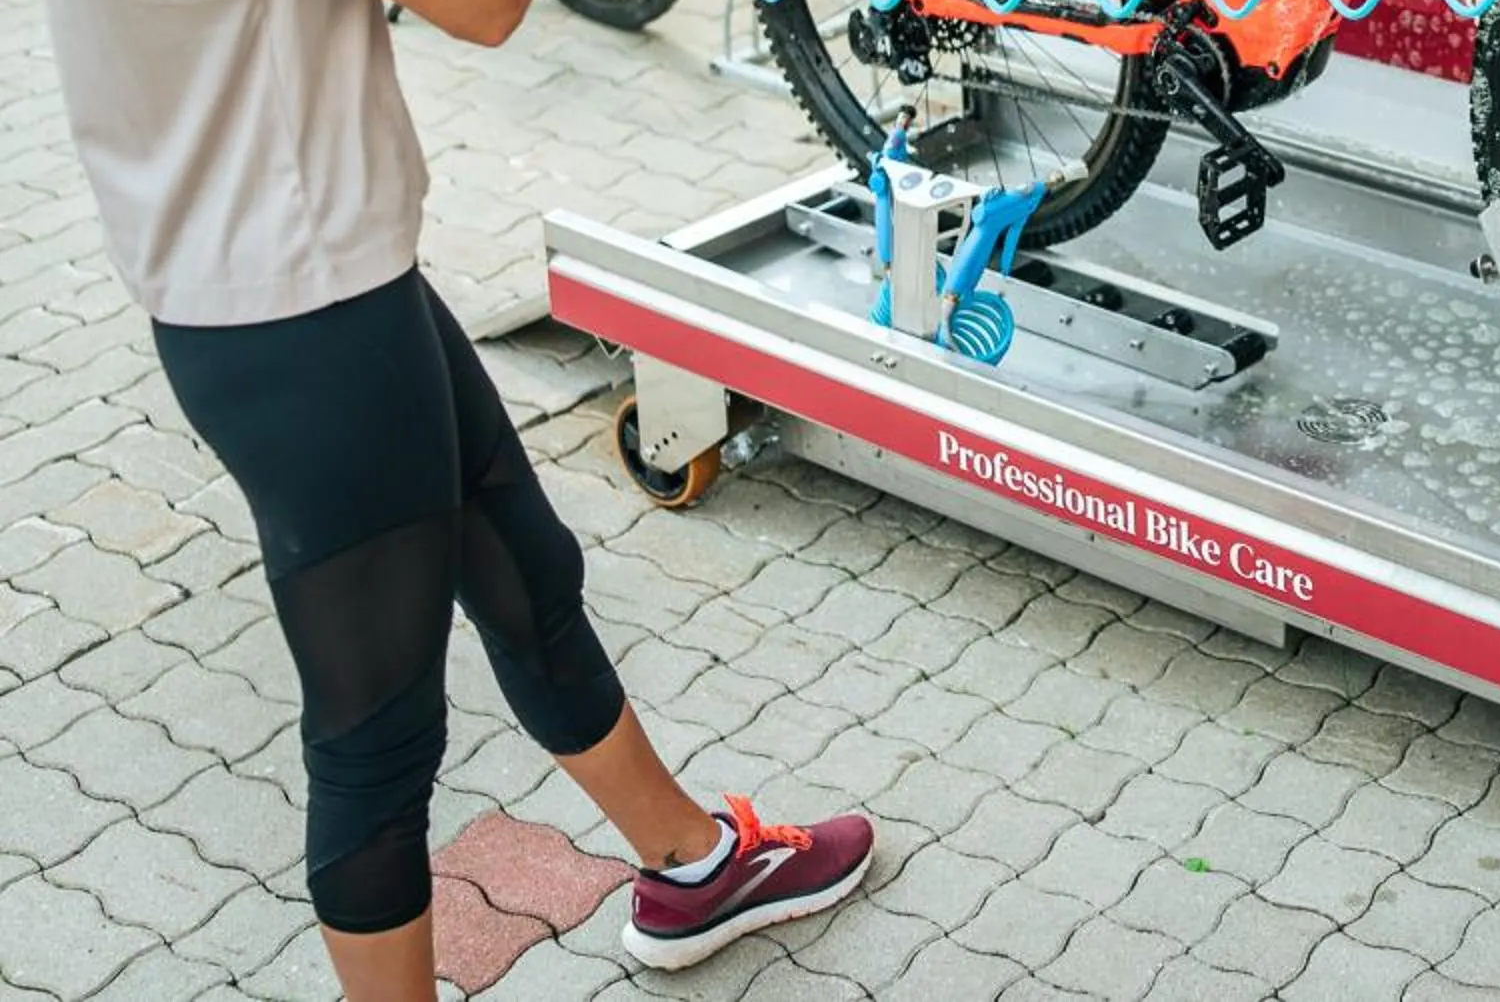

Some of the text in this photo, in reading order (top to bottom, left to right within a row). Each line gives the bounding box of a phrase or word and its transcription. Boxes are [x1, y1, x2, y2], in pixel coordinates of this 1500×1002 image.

[937, 430, 1314, 601] Professional Bike Care
